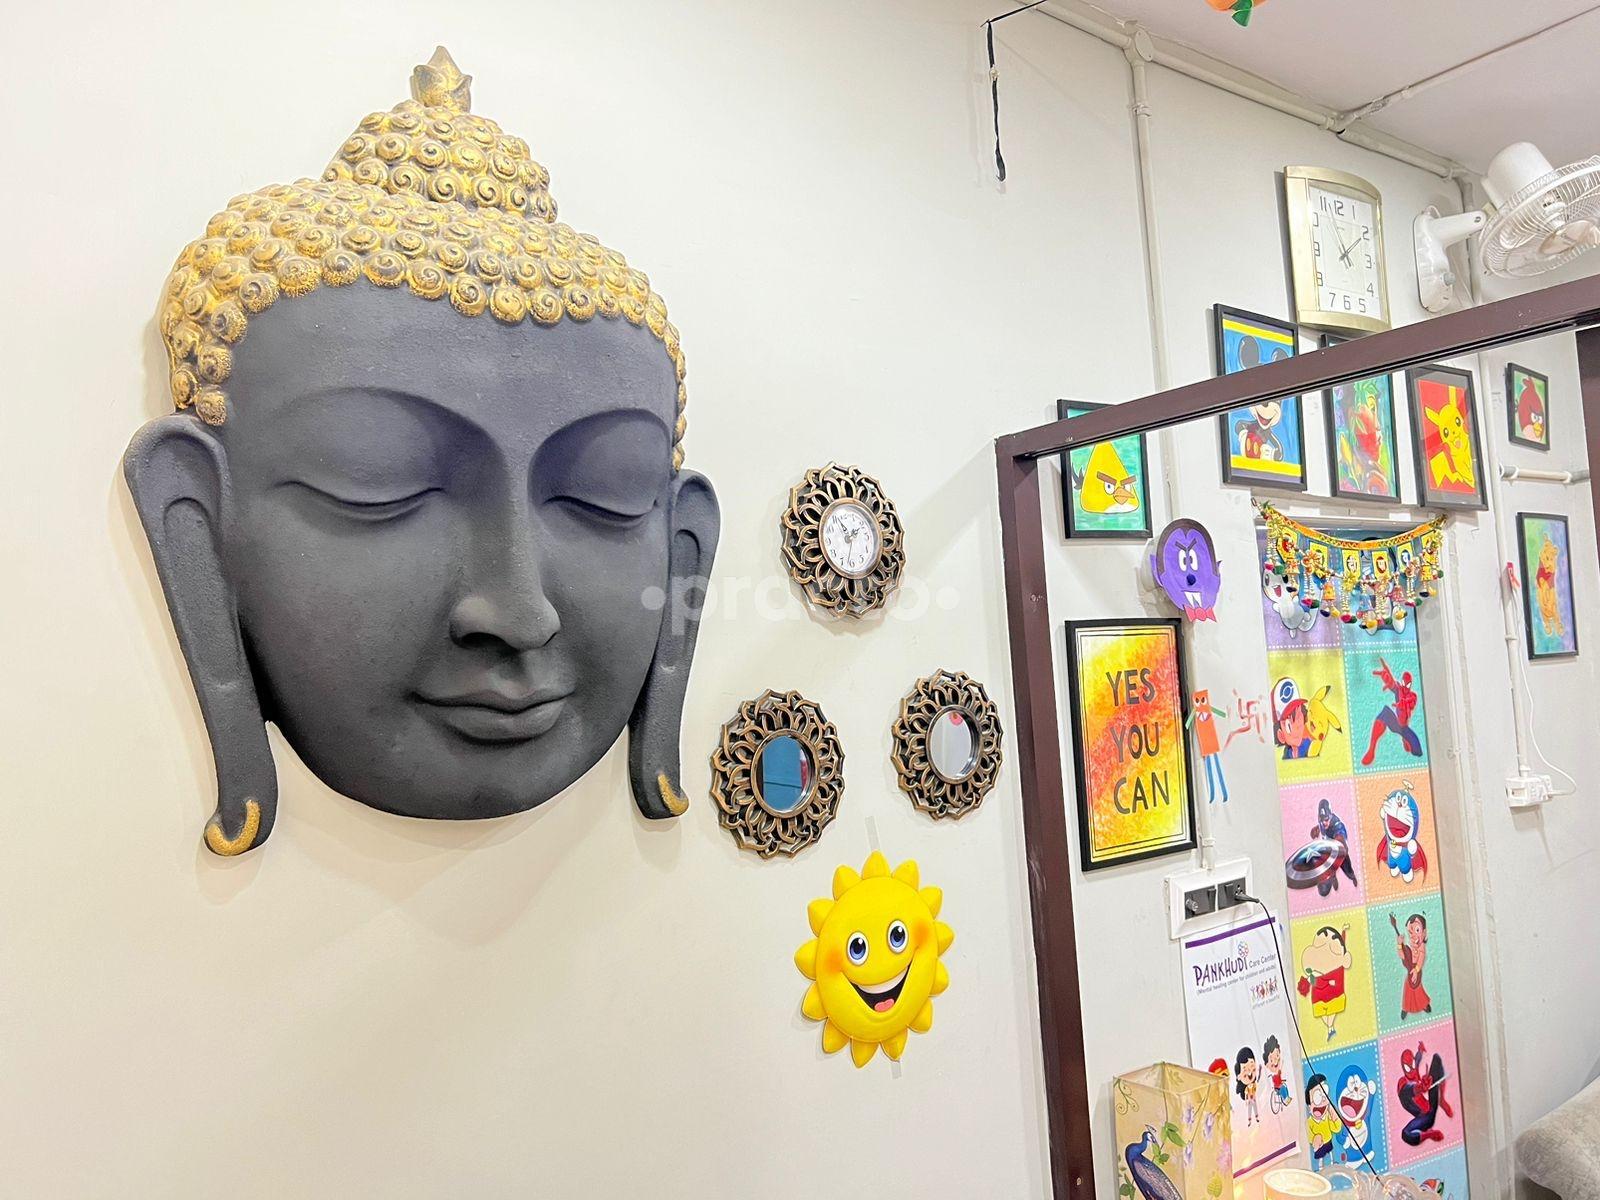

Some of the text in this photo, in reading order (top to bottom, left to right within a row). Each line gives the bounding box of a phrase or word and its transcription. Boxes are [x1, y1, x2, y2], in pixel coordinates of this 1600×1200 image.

[1319, 196, 1327, 212] 11
[1334, 199, 1344, 216] 12
[1361, 225, 1370, 241] 2
[1364, 253, 1372, 269] 3
[1366, 282, 1374, 297] 4
[1328, 292, 1337, 308] 7
[1343, 294, 1351, 311] 6
[1358, 298, 1367, 313] 5
[1105, 668, 1155, 706] YES
[1109, 722, 1160, 763] YOU
[1113, 770, 1170, 815] CAN
[1249, 959, 1261, 968] Care
[1261, 953, 1276, 964] Center
